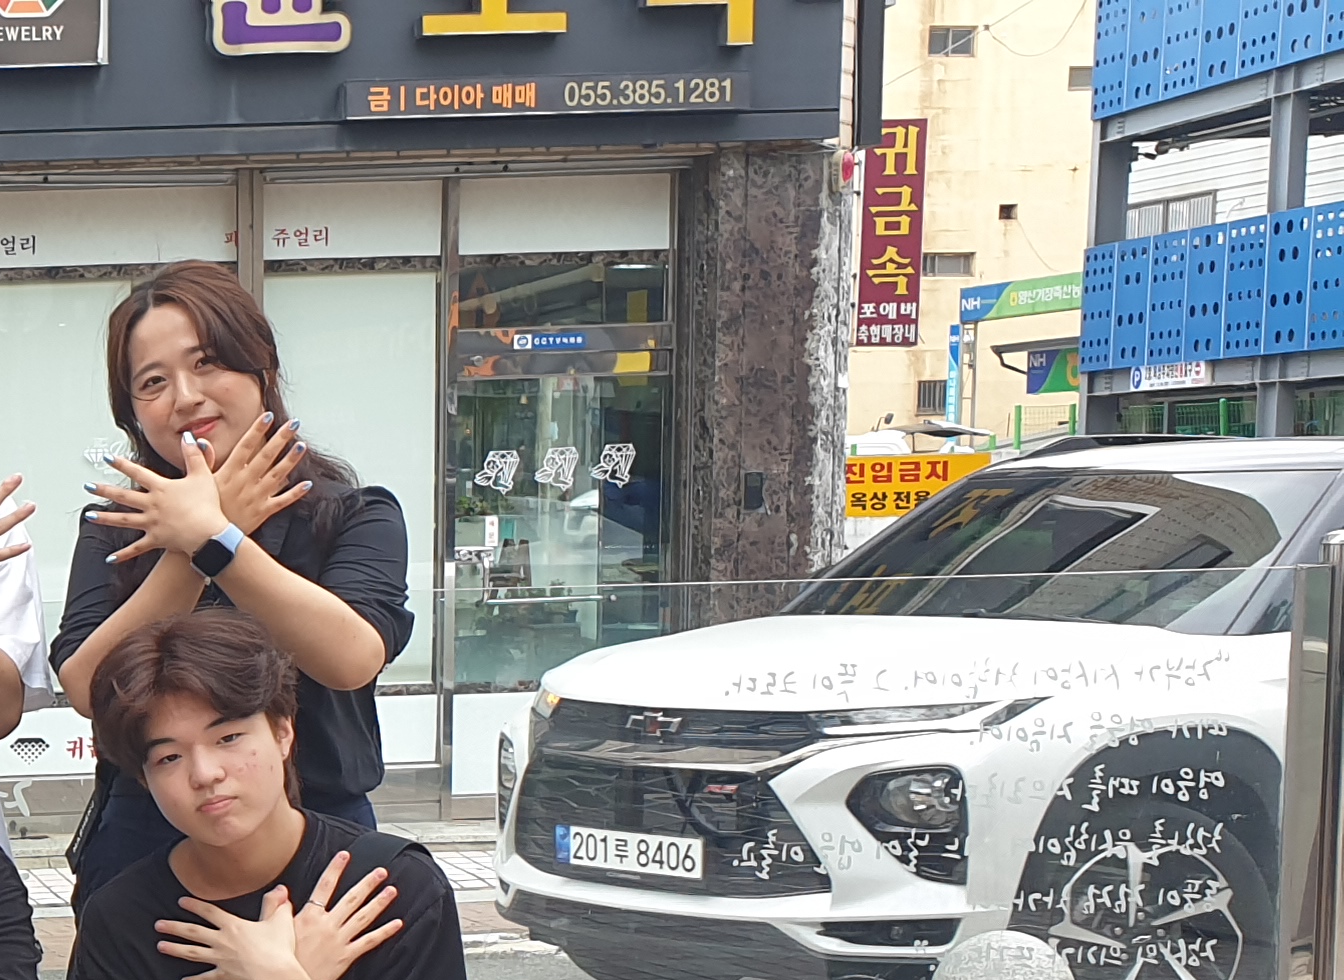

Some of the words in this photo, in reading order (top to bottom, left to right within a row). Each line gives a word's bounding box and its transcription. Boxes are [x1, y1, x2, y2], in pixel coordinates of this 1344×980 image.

[367, 87, 391, 111] 금
[415, 84, 484, 110] 다이아
[492, 82, 537, 109] 매매
[563, 78, 733, 107] 055.385.1281
[865, 125, 921, 295] 귀금속
[271, 226, 329, 247] 쥬얼리
[859, 302, 917, 320] 포에버
[961, 296, 981, 311] NH
[857, 323, 916, 344] 축협매장내
[1029, 353, 1047, 367] NH
[845, 460, 950, 484] 진입금지
[850, 491, 889, 512] 옥상
[571, 829, 630, 866] 201루
[635, 837, 697, 874] 8406
